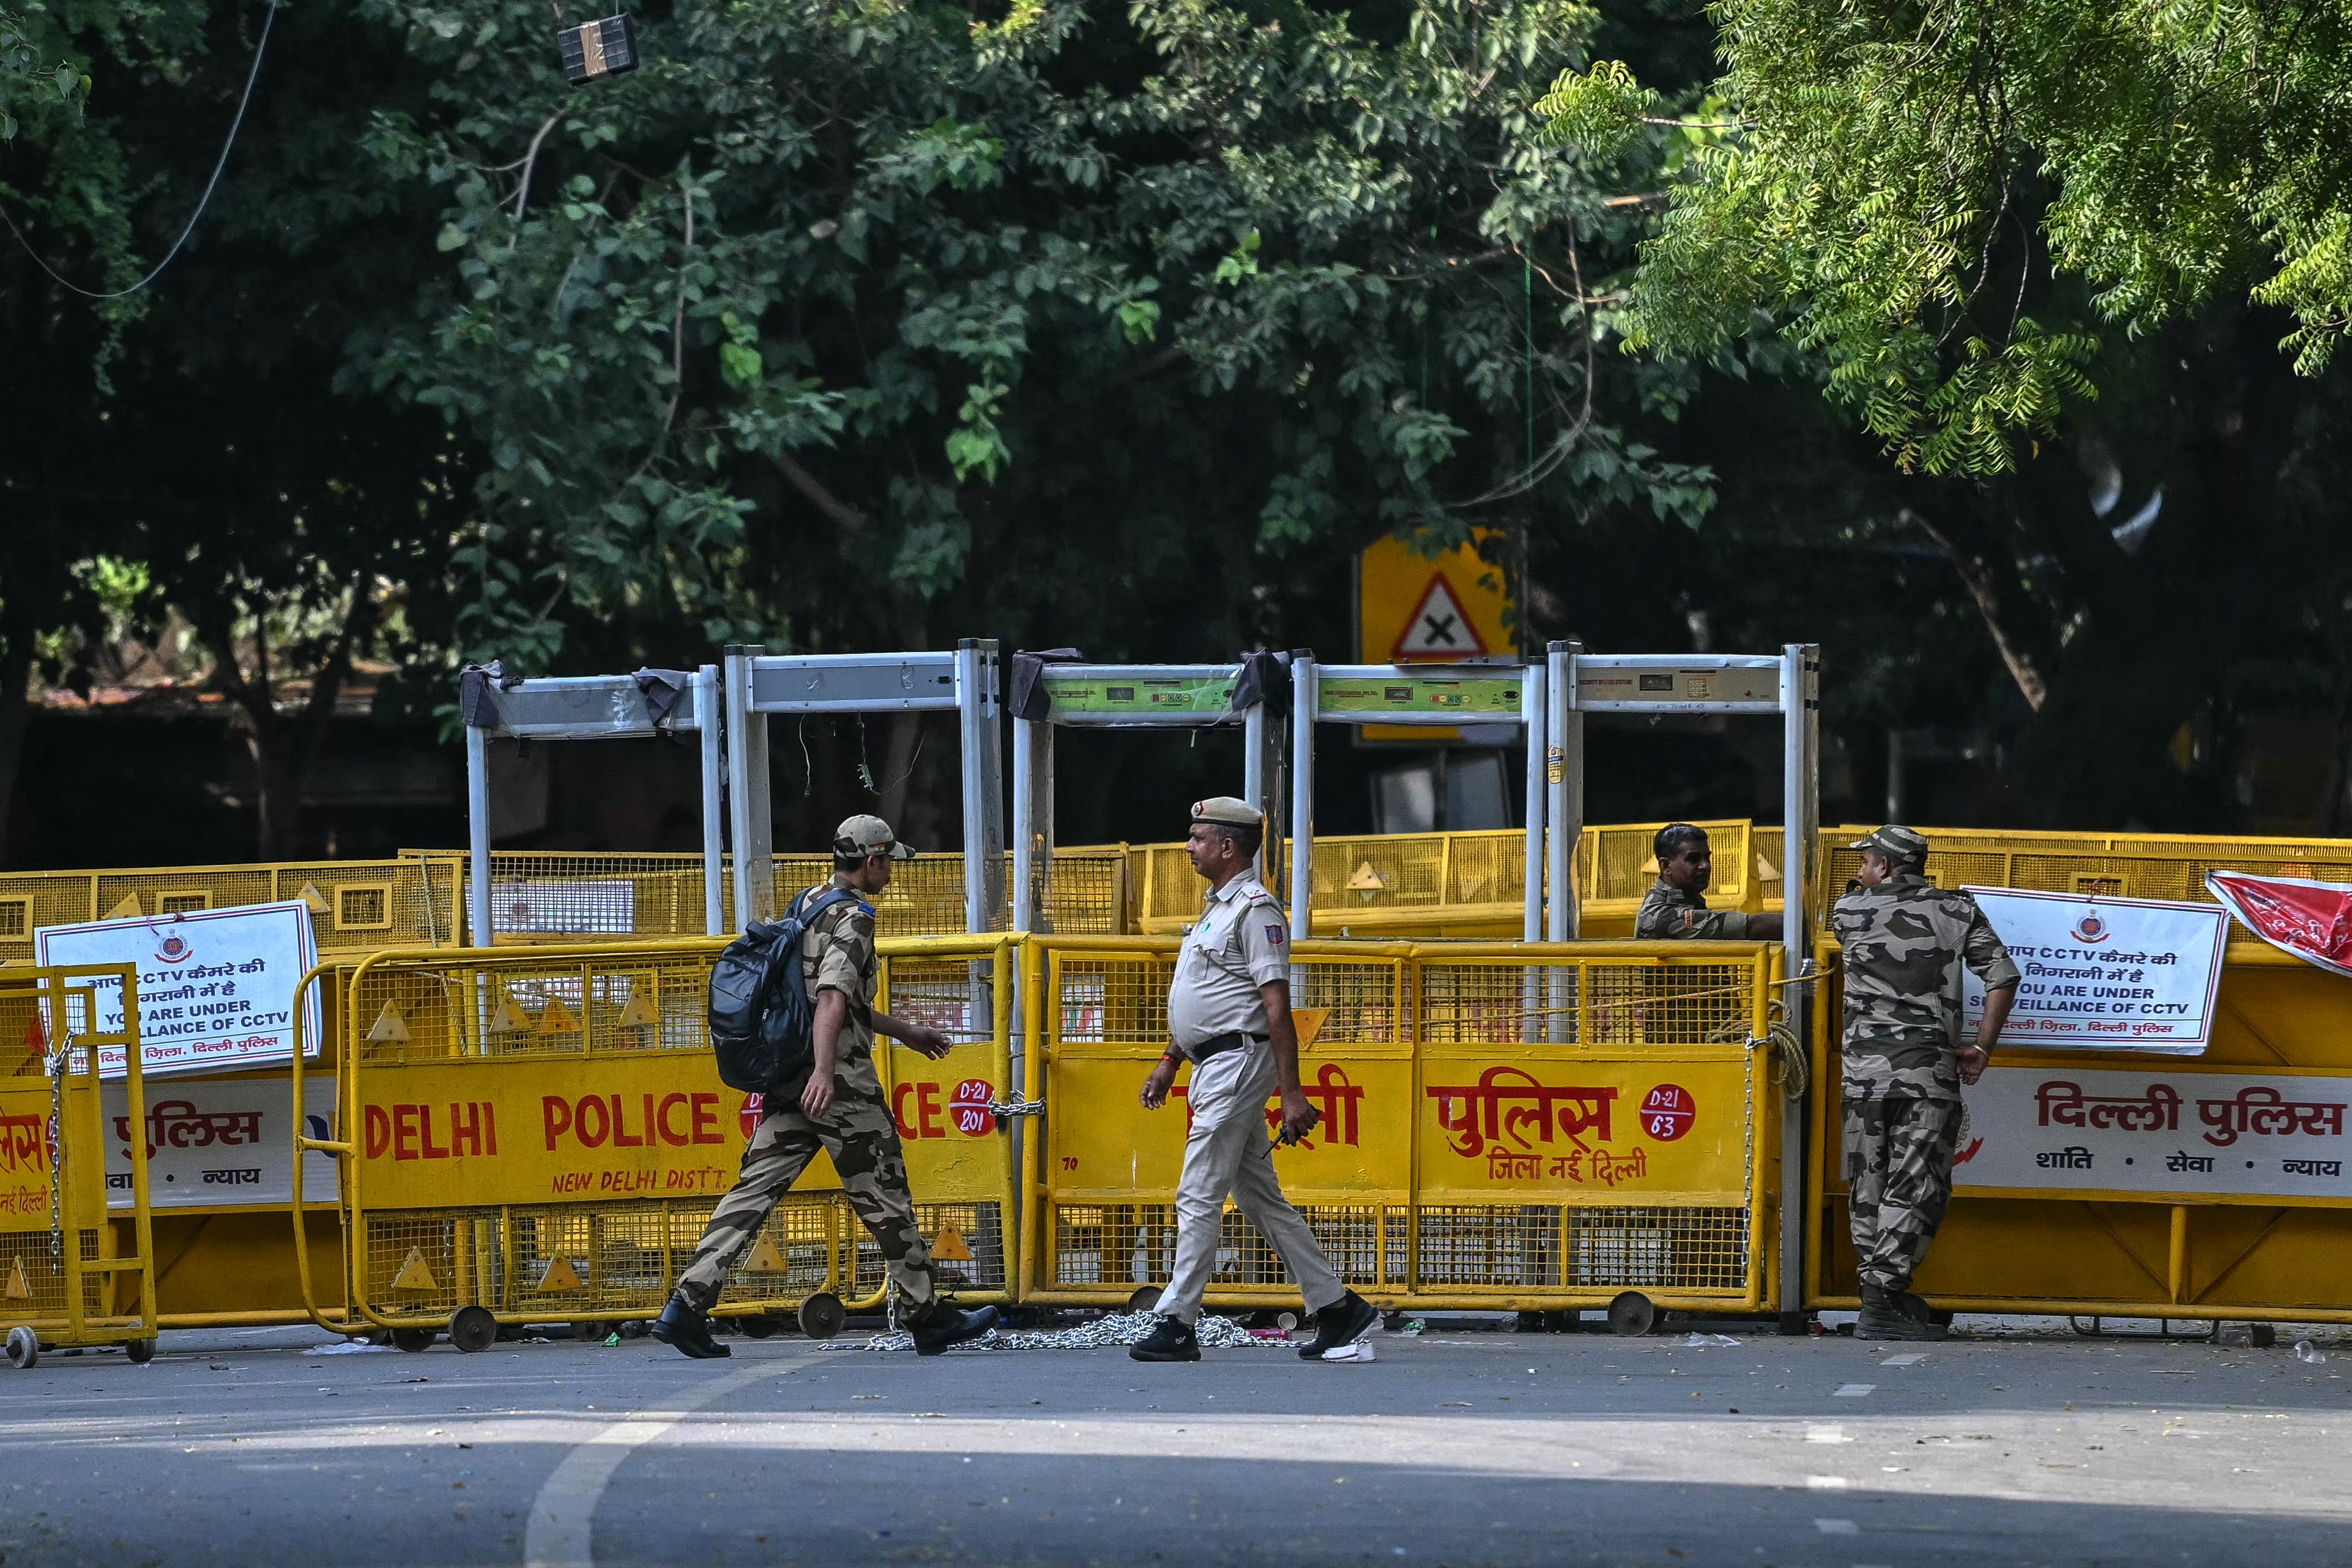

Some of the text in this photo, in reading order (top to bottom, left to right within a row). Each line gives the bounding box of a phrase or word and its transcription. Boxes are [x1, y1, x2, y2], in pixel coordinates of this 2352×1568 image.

[2040, 948, 2096, 961] CCTV
[2099, 949, 2148, 965] कैमरे
[2150, 952, 2178, 965] की
[187, 962, 236, 979] कैमरे
[239, 958, 266, 973] की
[2025, 962, 2144, 983] निगरानी में है
[199, 982, 220, 997] में
[221, 981, 236, 995] है
[2019, 983, 2154, 999] OU ARE UNDER
[148, 1007, 183, 1022] ARE
[189, 1000, 251, 1016] UNDER
[2112, 1002, 2135, 1014] OF
[2140, 1003, 2189, 1015] CCTV
[212, 1018, 234, 1030] OF
[241, 1011, 289, 1028] CCTV
[2088, 1021, 2128, 1033] दिल्ली
[2132, 1023, 2174, 1036] पुलिस
[192, 1039, 233, 1053] दिल्ली
[237, 1036, 279, 1052] पुलिस
[959, 1081, 986, 1099] D-21
[1648, 1088, 1680, 1108] D-21
[961, 1110, 984, 1132] 201
[1426, 1066, 1620, 1158] पुलिस
[2034, 1080, 2348, 1147] दिल्ली पुलिस
[364, 1092, 725, 1161] DELHI POLICE
[1651, 1116, 1675, 1137] 63
[1486, 1145, 1647, 1187] जिला नई दिल्ली
[2036, 1146, 2342, 1177] शांति सेवा न्याय
[202, 1168, 262, 1185] न्याय
[553, 1172, 593, 1194] NEW
[600, 1170, 657, 1192] DELHI
[19, 1184, 48, 1215] दिल्ली
